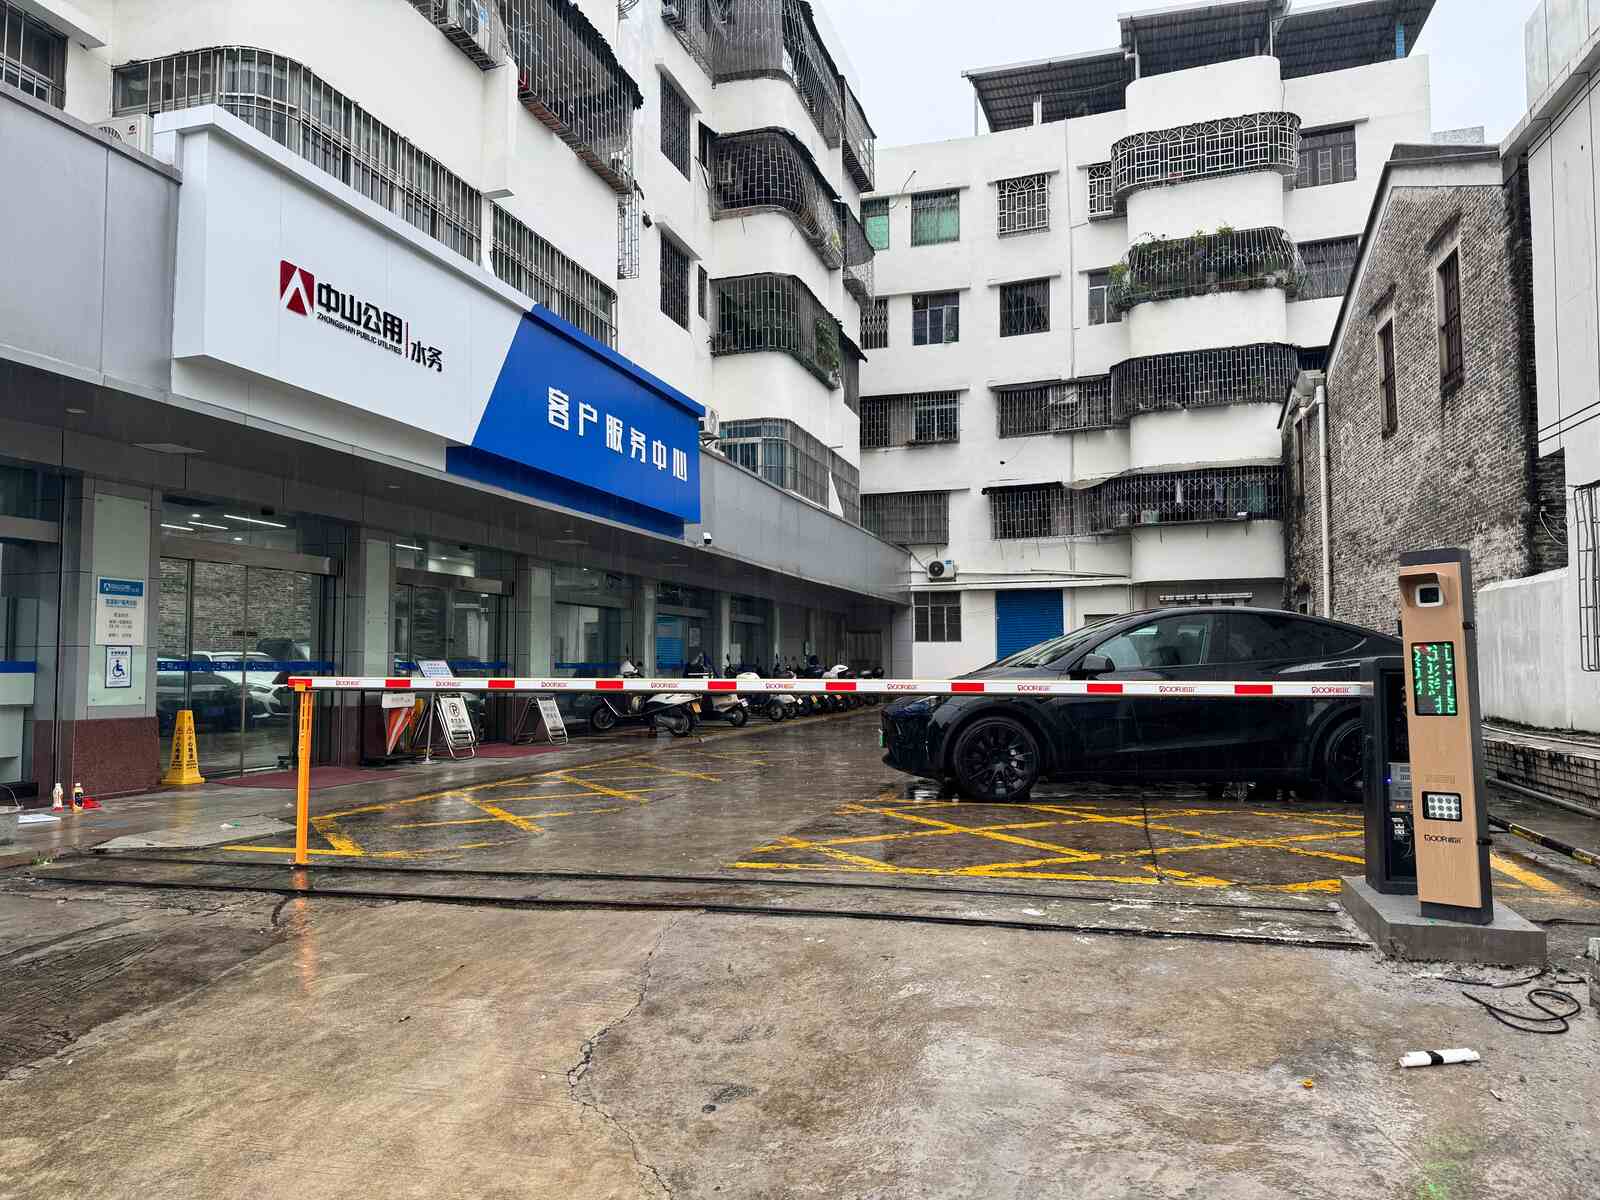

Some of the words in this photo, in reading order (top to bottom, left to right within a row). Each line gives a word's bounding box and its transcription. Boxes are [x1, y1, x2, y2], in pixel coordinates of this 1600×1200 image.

[317, 282, 403, 345] 中山公用
[317, 311, 356, 336] ZHONGSHAN
[356, 329, 378, 345] PUBLIC
[377, 338, 403, 356] UTILITIES
[410, 340, 443, 373] 水务
[548, 386, 688, 482] 客户服务中心
